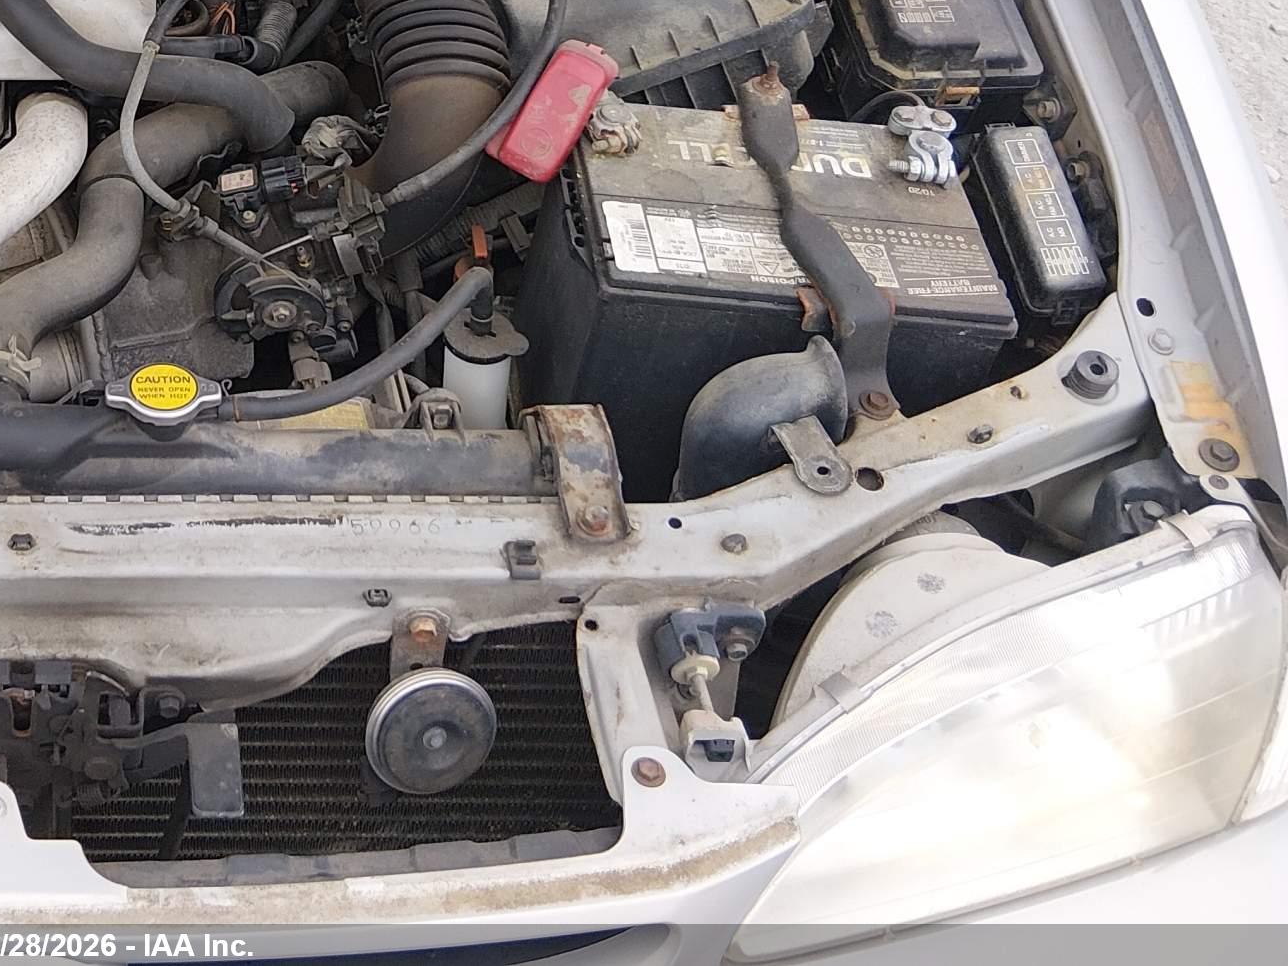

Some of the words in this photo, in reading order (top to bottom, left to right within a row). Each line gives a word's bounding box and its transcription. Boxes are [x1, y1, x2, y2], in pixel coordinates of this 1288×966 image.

[908, 186, 935, 197] 10/20
[930, 279, 970, 287] BATTERY
[136, 375, 191, 384] CAUTION
